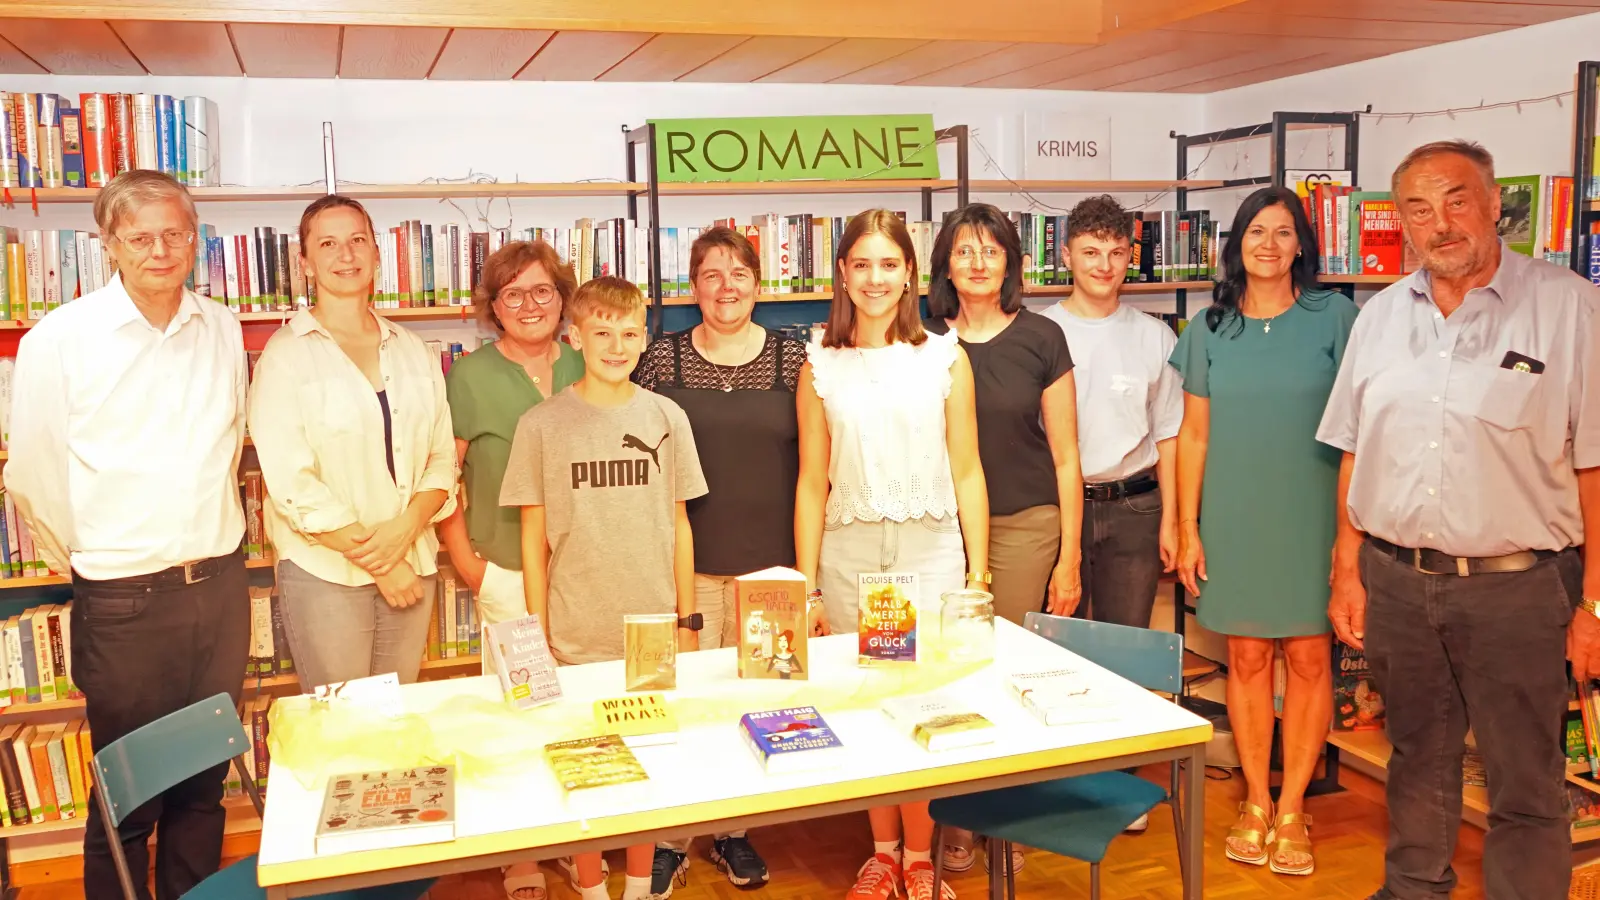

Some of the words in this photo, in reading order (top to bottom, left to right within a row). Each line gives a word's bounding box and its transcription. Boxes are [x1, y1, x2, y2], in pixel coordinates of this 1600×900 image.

[18, 137, 27, 154] KEN
[666, 127, 924, 173] ROMANE
[1037, 140, 1098, 158] KRIMIS
[1365, 211, 1376, 219] WIR
[1378, 211, 1391, 219] SIND
[1364, 219, 1401, 231] MEHRHEIT
[781, 242, 789, 275] VOX
[571, 458, 649, 489] PUMA
[862, 575, 892, 584] LOUISE
[896, 575, 914, 584] PELT
[874, 599, 902, 609] HALB
[869, 610, 907, 620] WERTS
[877, 621, 900, 631] ZEIT
[512, 627, 541, 640] Meine
[512, 640, 546, 655] Kinder
[869, 636, 907, 648] GLÜCK
[748, 710, 781, 720] MATT
[784, 707, 814, 716] HAIG
[361, 788, 411, 808] FILM
